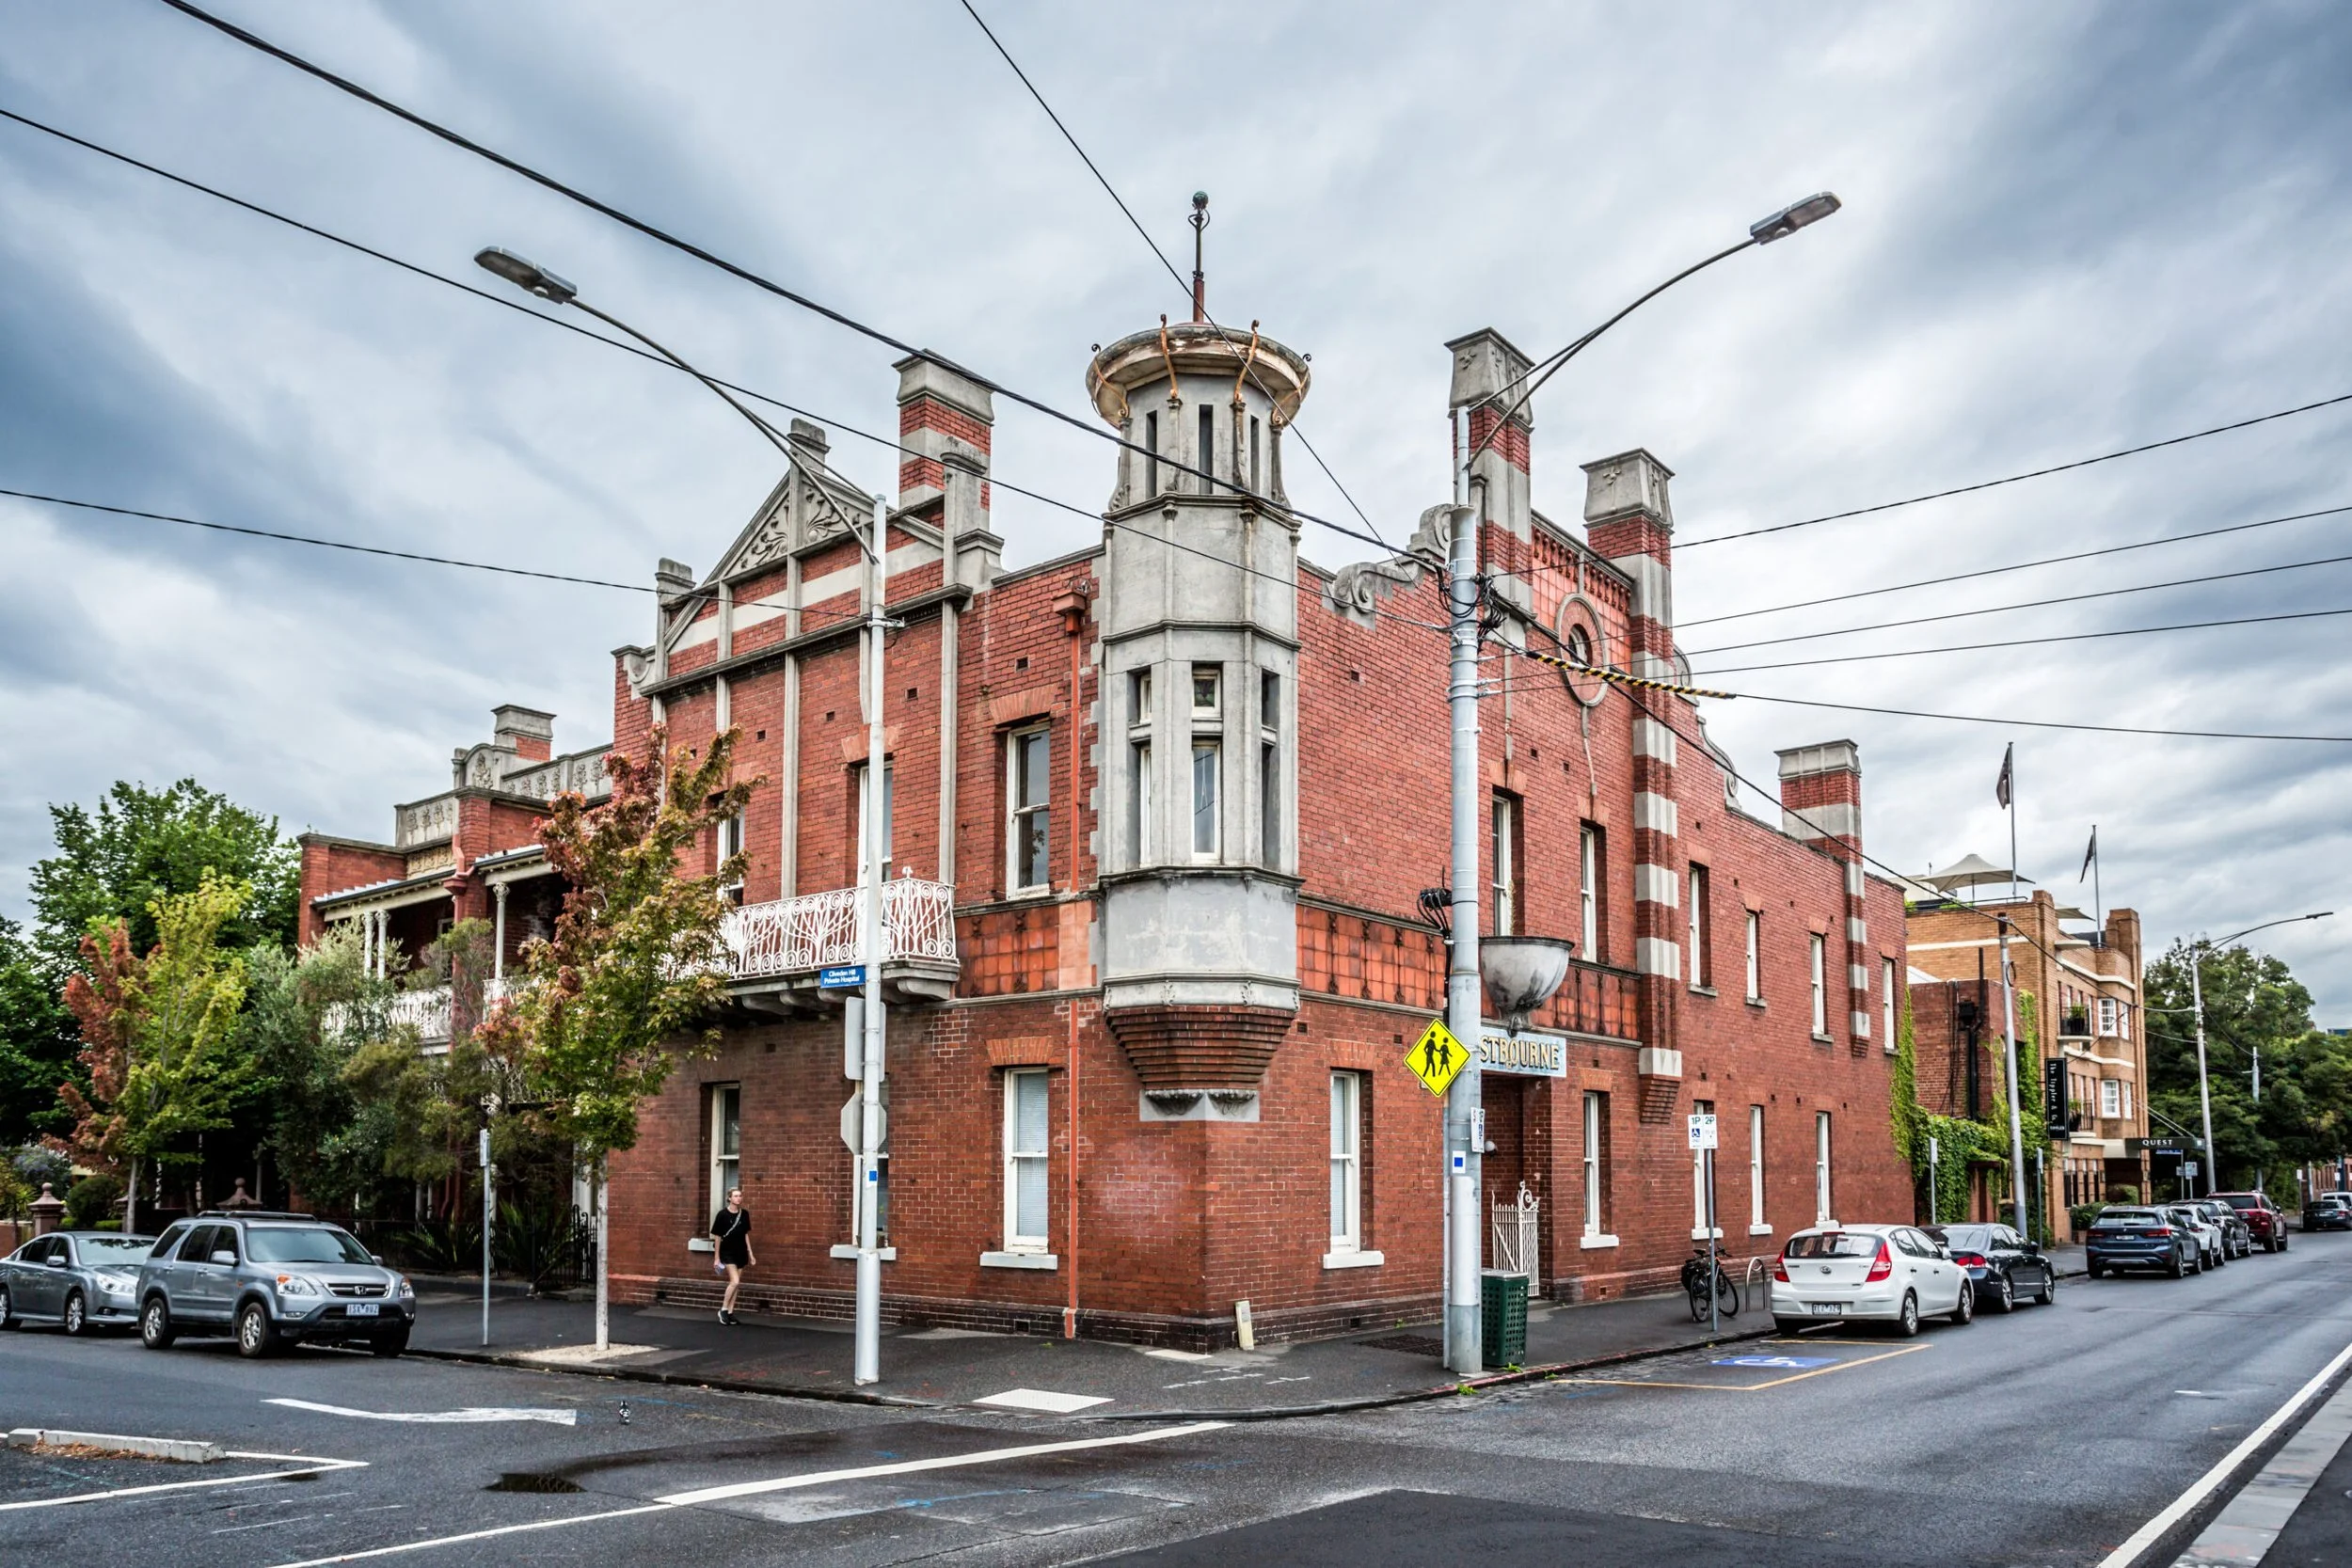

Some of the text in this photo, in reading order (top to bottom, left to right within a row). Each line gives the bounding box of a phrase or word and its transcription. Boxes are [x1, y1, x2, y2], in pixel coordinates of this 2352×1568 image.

[2048, 1078, 2058, 1102] Tippler
[1692, 1117, 1701, 1125] 1P
[1705, 1117, 1715, 1125] 2P
